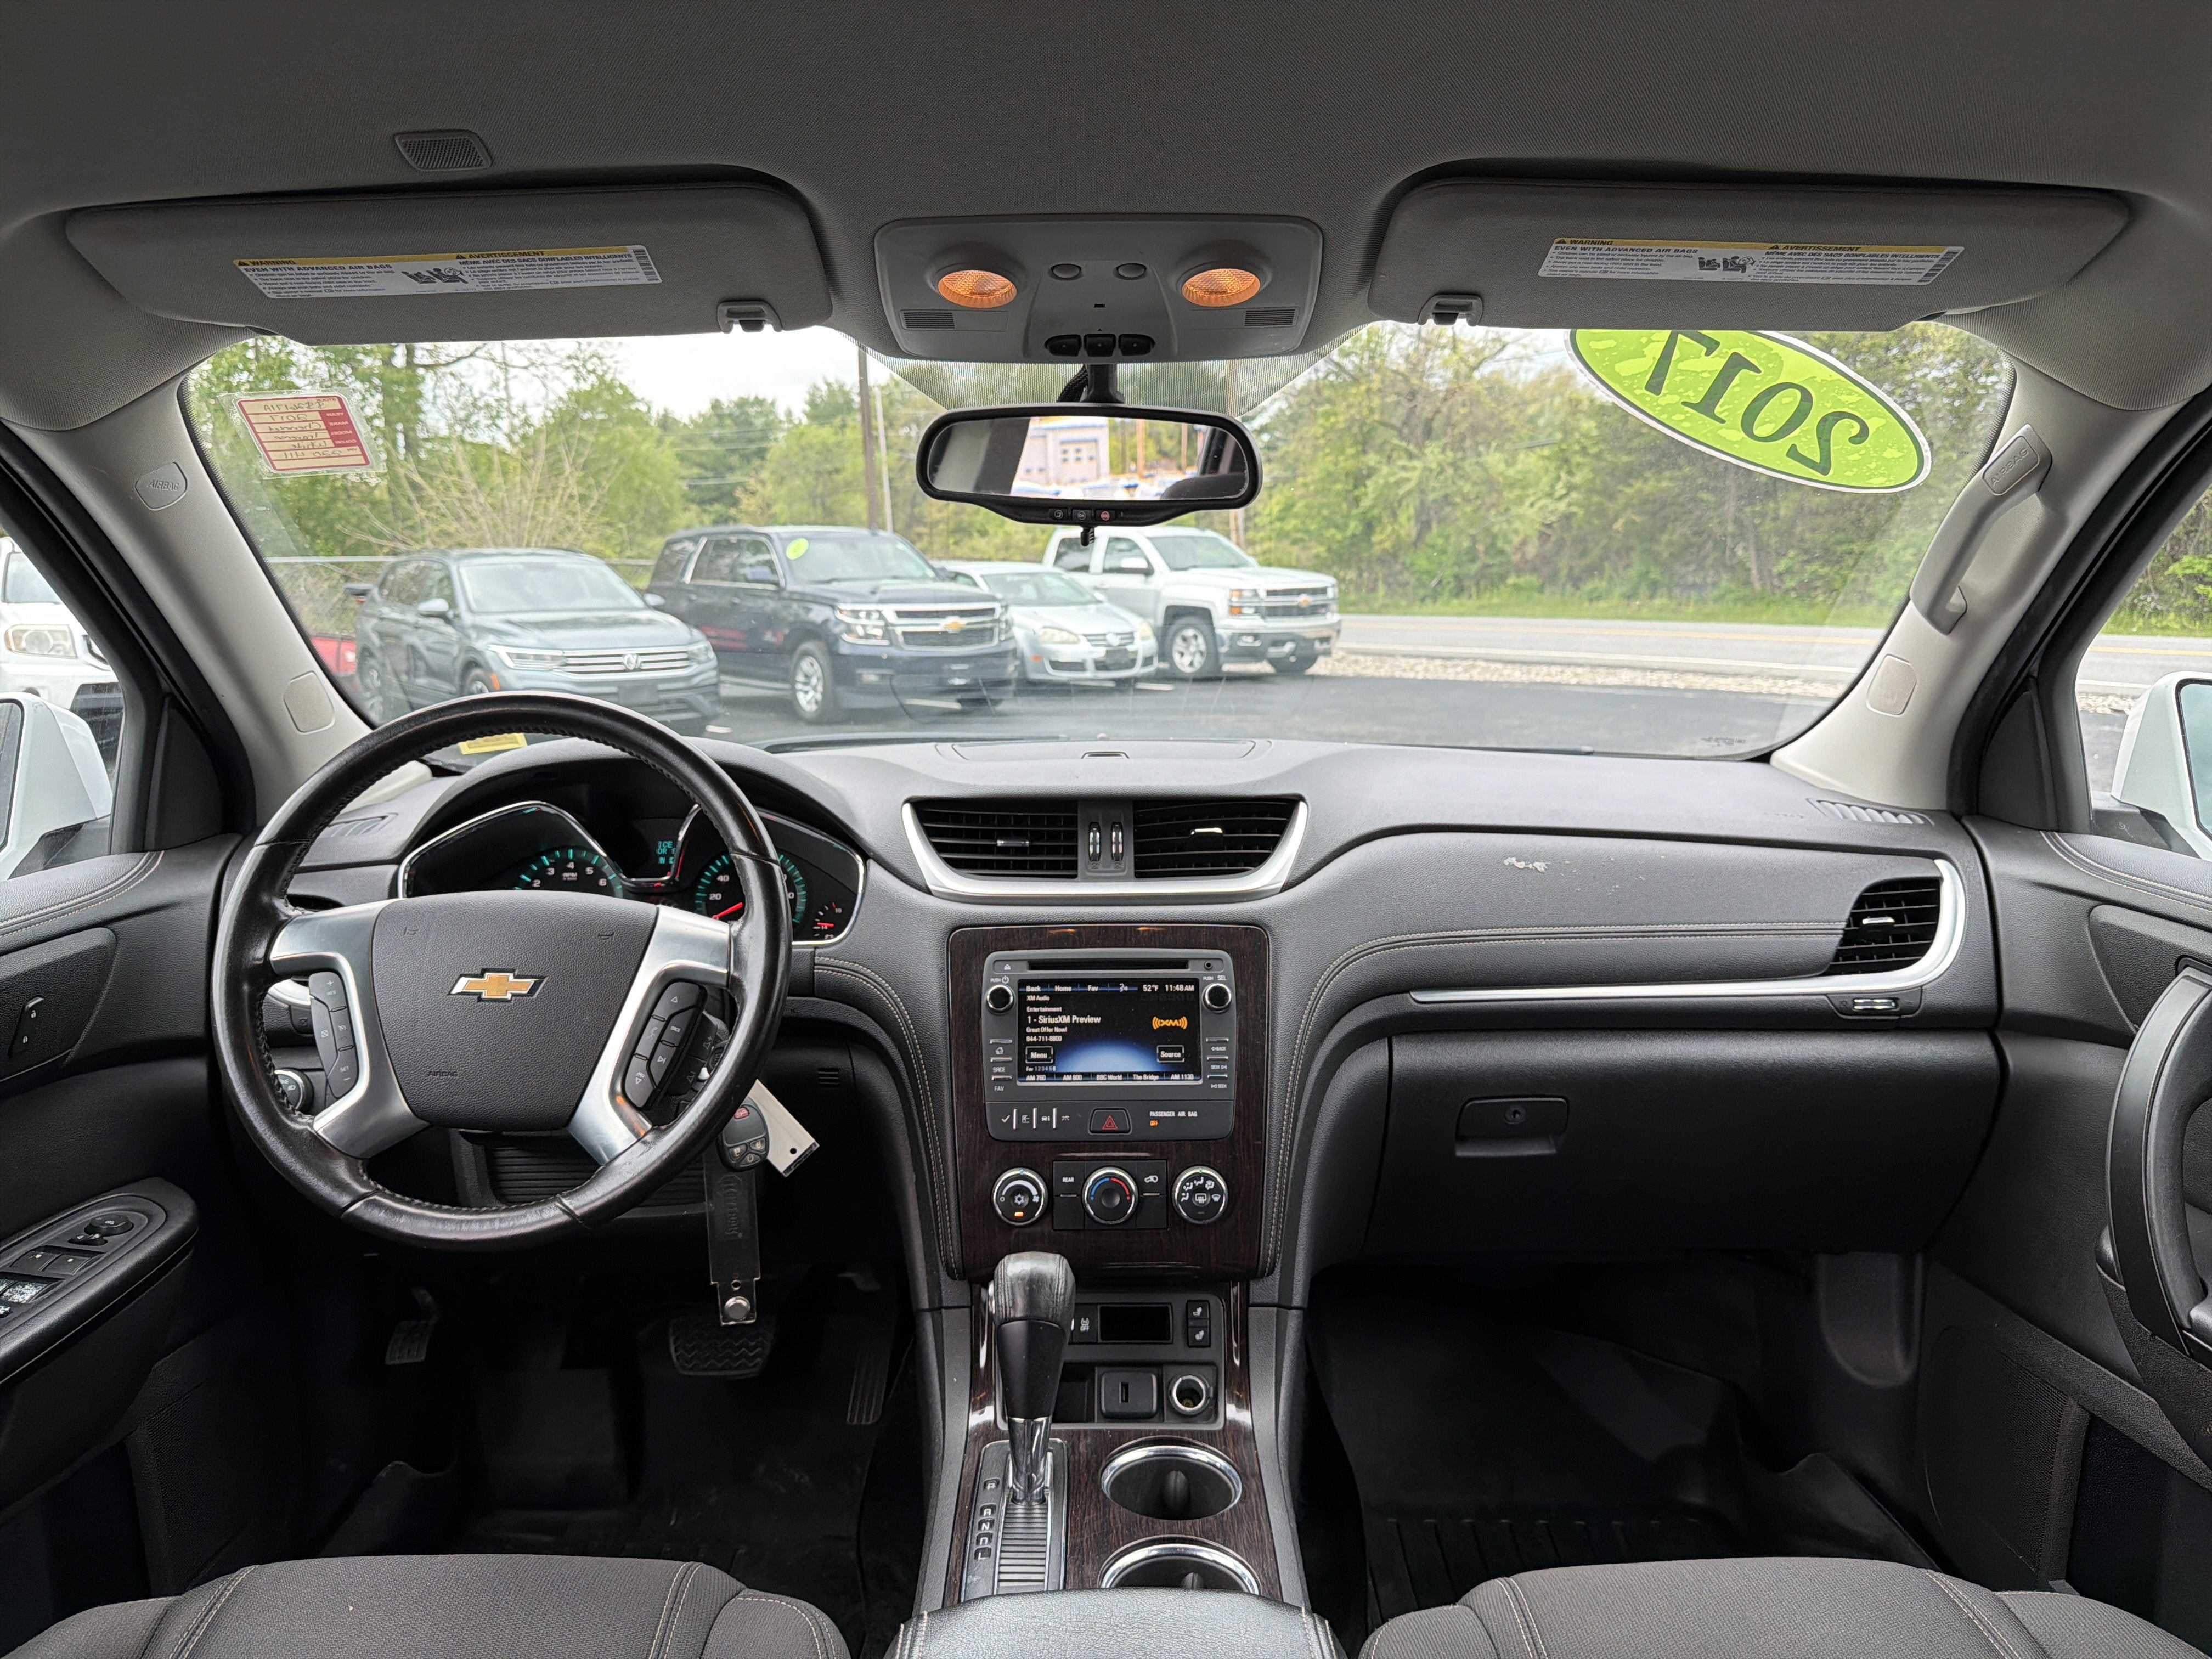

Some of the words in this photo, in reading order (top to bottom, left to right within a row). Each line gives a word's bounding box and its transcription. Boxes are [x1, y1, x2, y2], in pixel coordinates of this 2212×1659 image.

[469, 251, 545, 259] AVERTISSEMENT
[1990, 447, 2029, 487] AIRBAG
[146, 479, 179, 492] AIRBAG
[585, 867, 594, 875] 5
[981, 1522, 990, 1531] N
[978, 1552, 989, 1560] L
